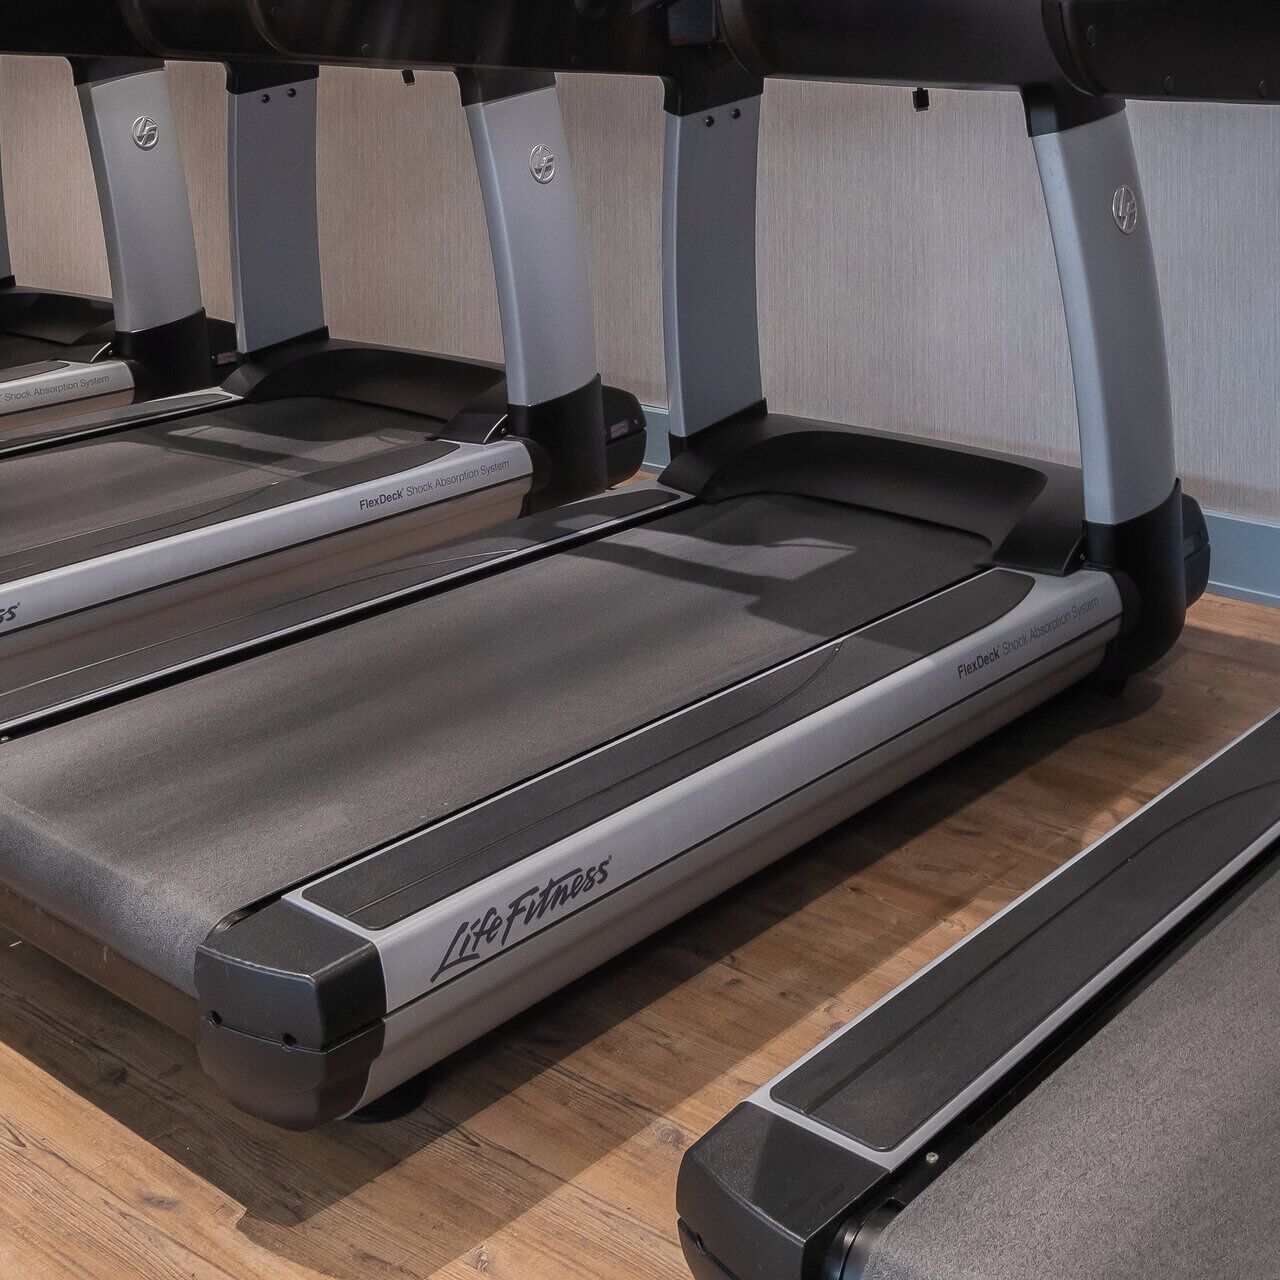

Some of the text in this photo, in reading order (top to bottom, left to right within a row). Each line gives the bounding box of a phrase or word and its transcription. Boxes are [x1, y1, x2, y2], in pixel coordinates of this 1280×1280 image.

[4, 390, 32, 402] Shock
[33, 381, 79, 396] Absorption
[79, 375, 110, 388] System
[359, 459, 510, 511] FlexDeck Shock Absorption System
[956, 596, 1100, 680] FlexDeck Shock Absorption System
